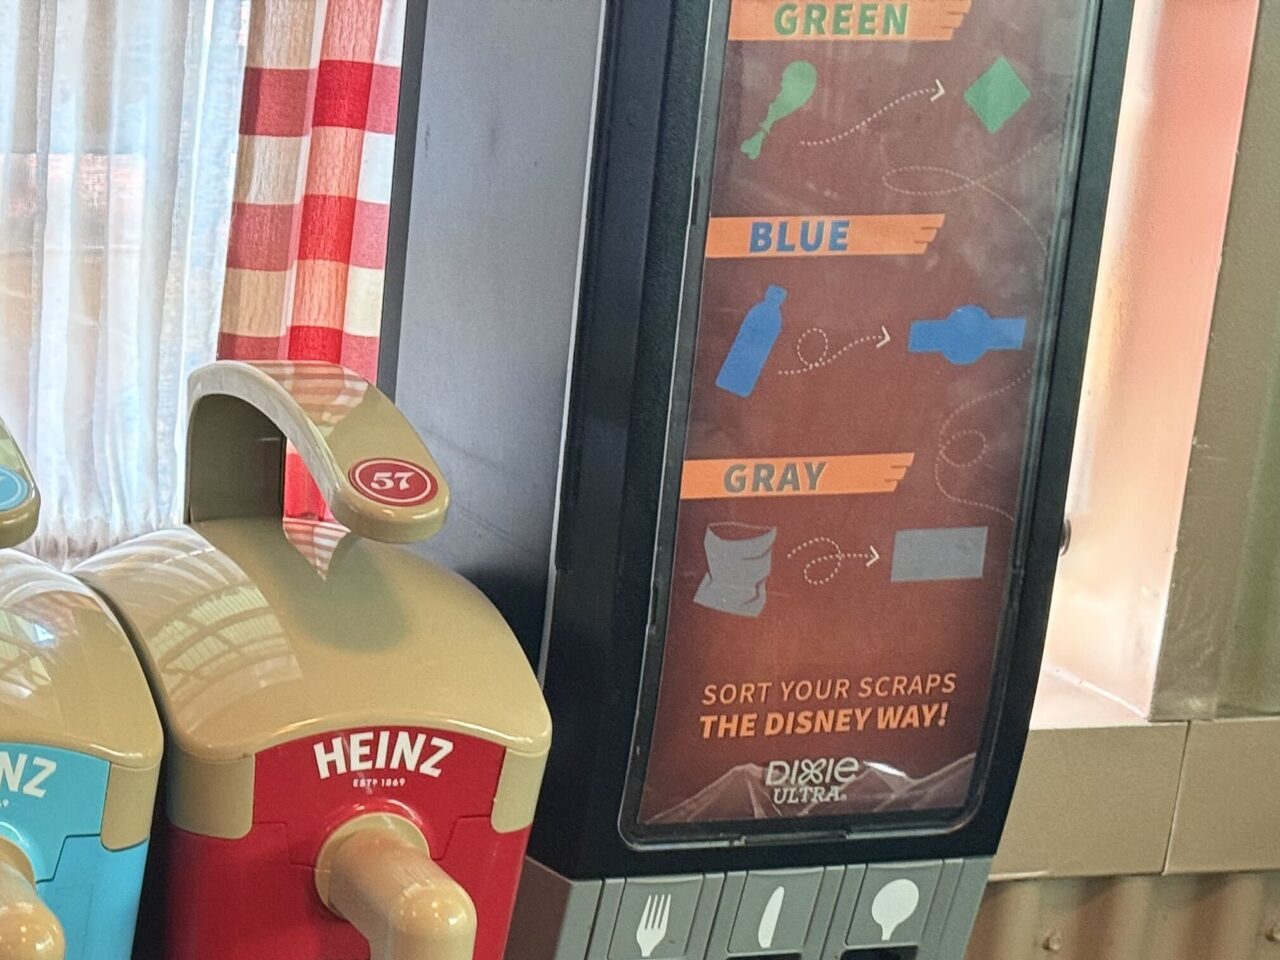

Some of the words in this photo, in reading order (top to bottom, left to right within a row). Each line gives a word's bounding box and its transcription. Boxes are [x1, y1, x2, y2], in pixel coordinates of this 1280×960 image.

[773, 2, 909, 36] GREEN
[748, 219, 850, 254] BLUE
[370, 471, 416, 491] 57
[723, 461, 828, 493] GRAY
[701, 682, 773, 706] SORT
[780, 676, 851, 701] YOUR
[857, 672, 958, 698] SCRAPS
[699, 712, 757, 740] THE
[764, 706, 874, 736] DISNEY
[876, 702, 949, 729] WAY!
[312, 730, 455, 780] HEINZ
